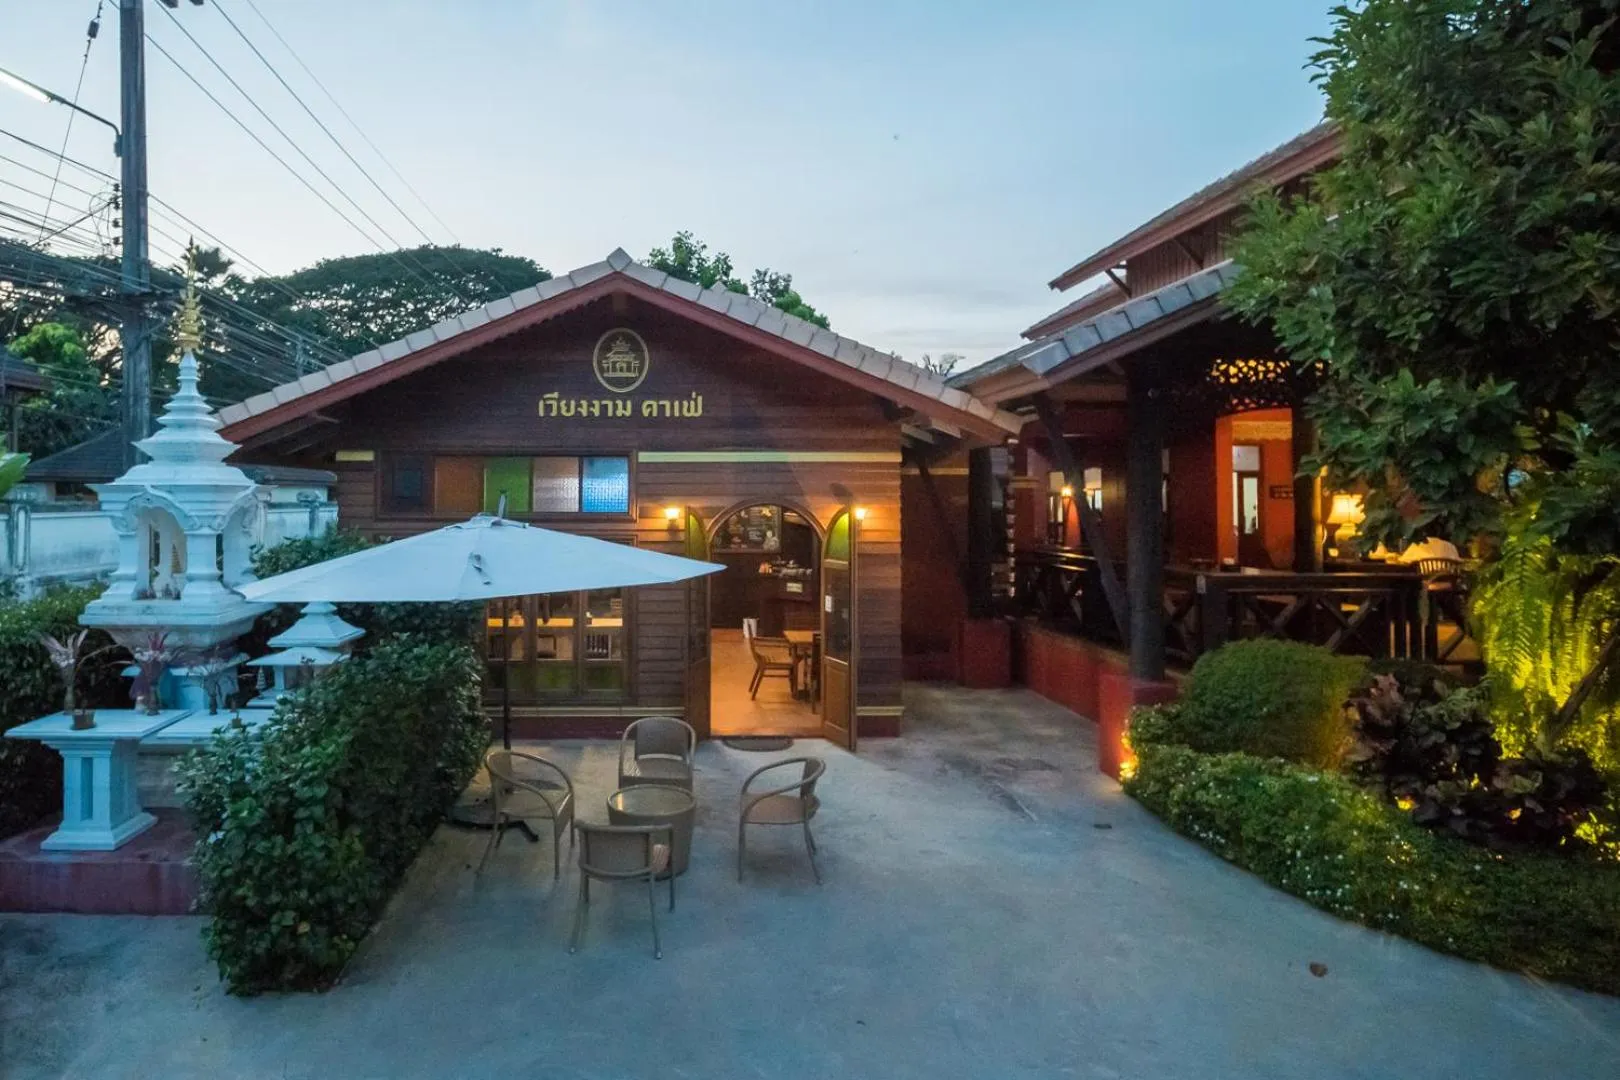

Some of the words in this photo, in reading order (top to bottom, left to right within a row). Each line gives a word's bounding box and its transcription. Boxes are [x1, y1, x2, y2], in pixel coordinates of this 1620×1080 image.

[538, 391, 632, 417] เวียงงาม
[641, 391, 703, 417] คาเฟ่
